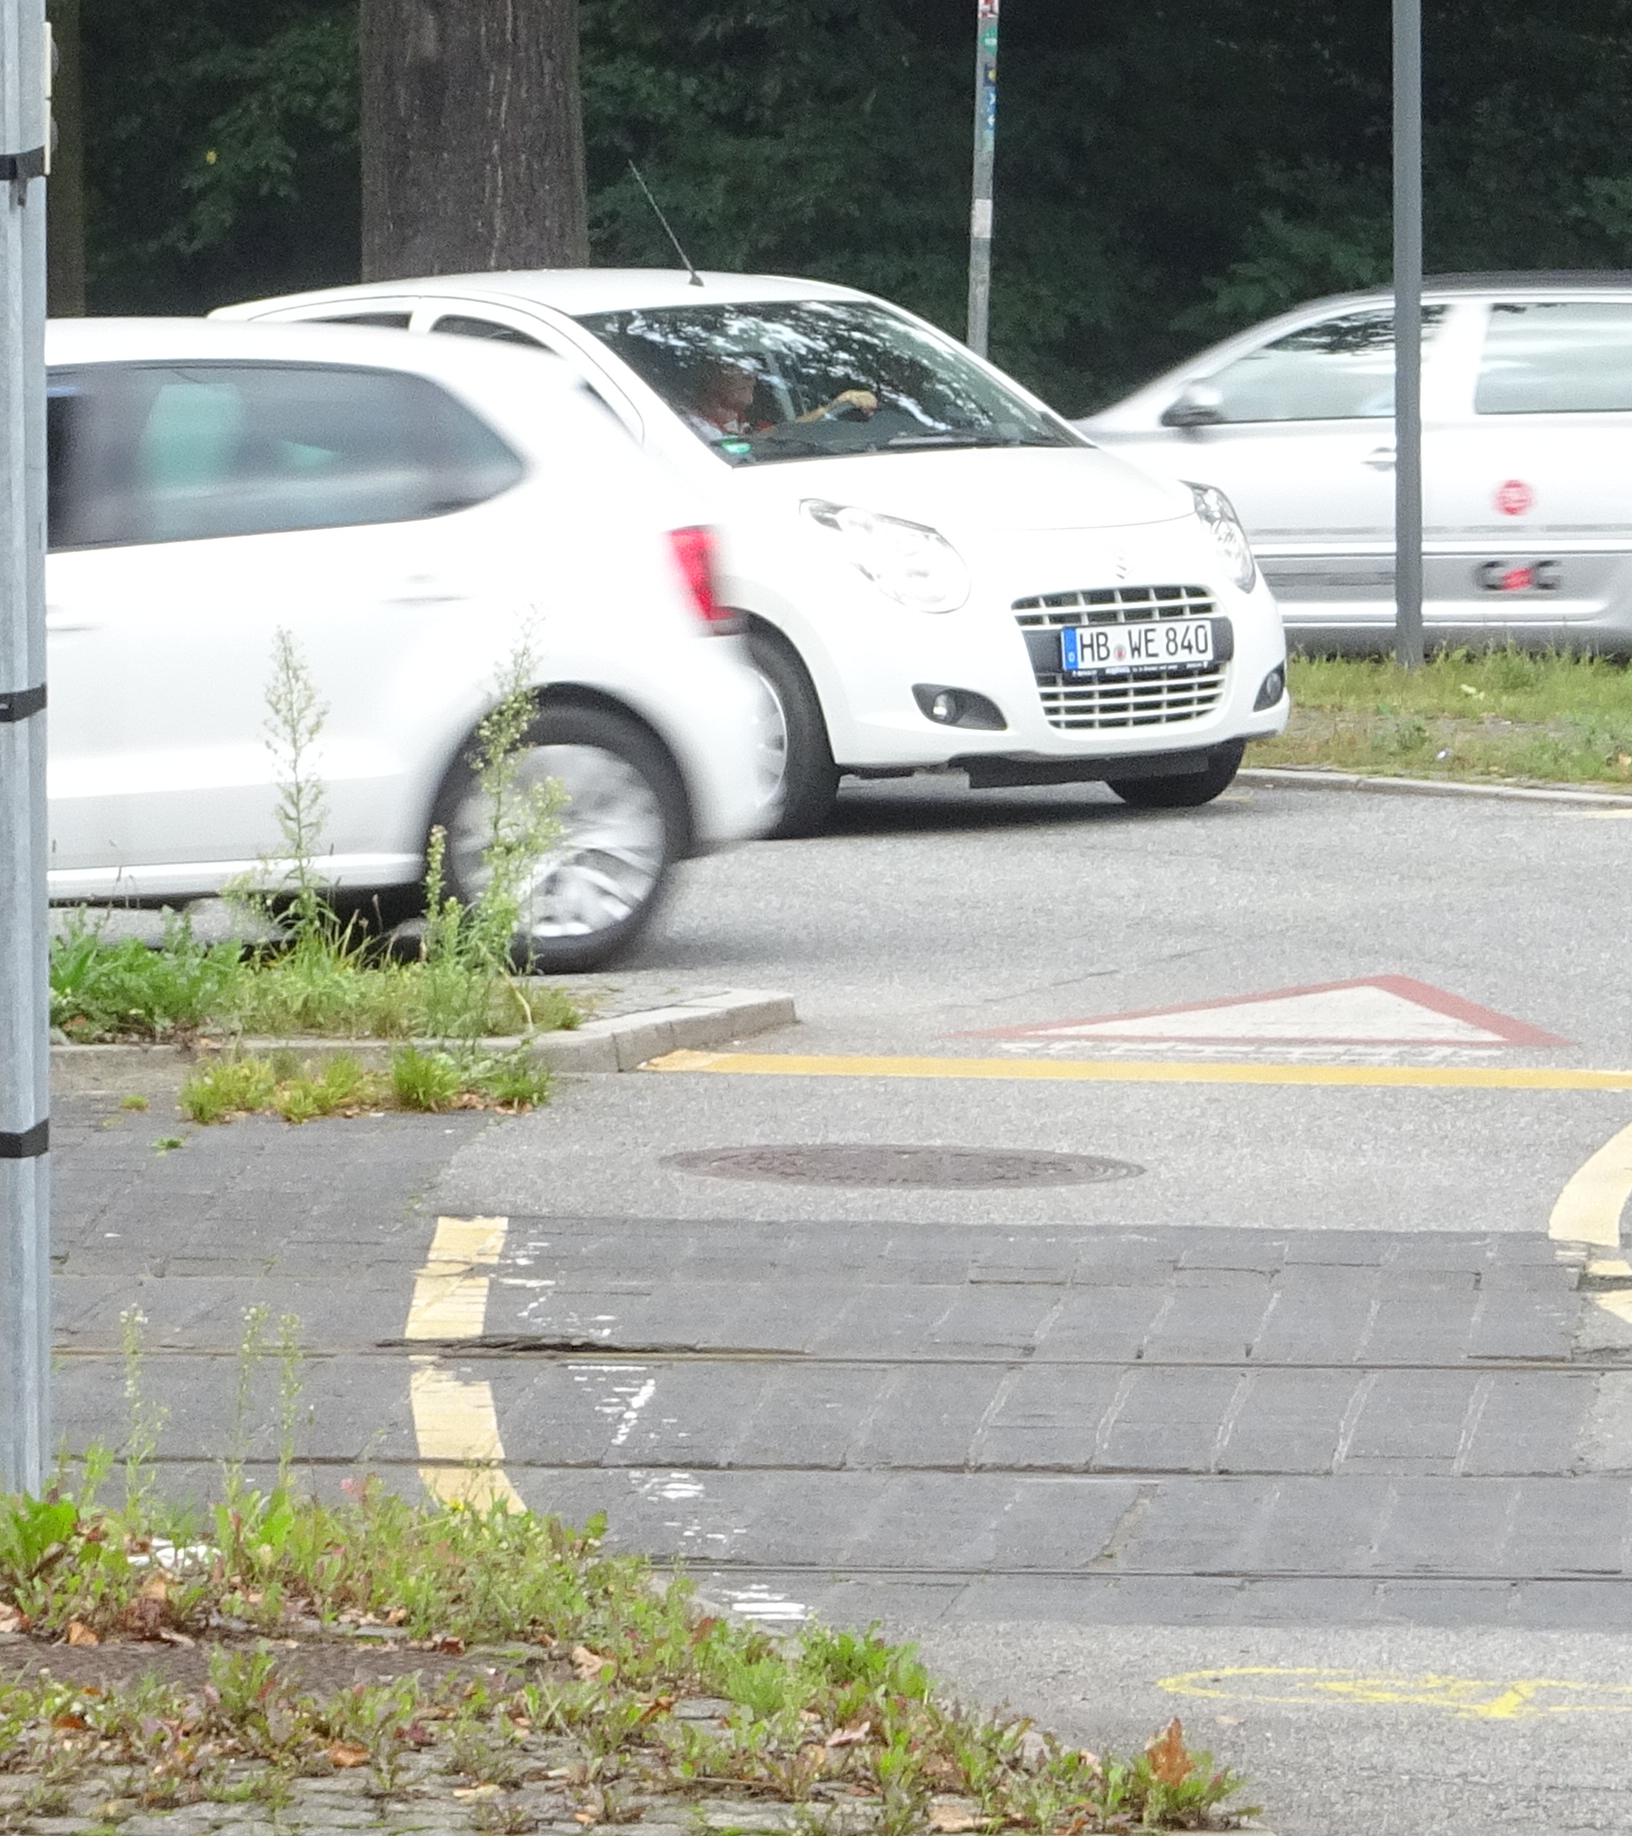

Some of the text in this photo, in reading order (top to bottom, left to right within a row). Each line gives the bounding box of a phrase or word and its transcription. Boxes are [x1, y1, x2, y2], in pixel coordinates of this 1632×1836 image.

[1079, 624, 1209, 663] HB WE 840
